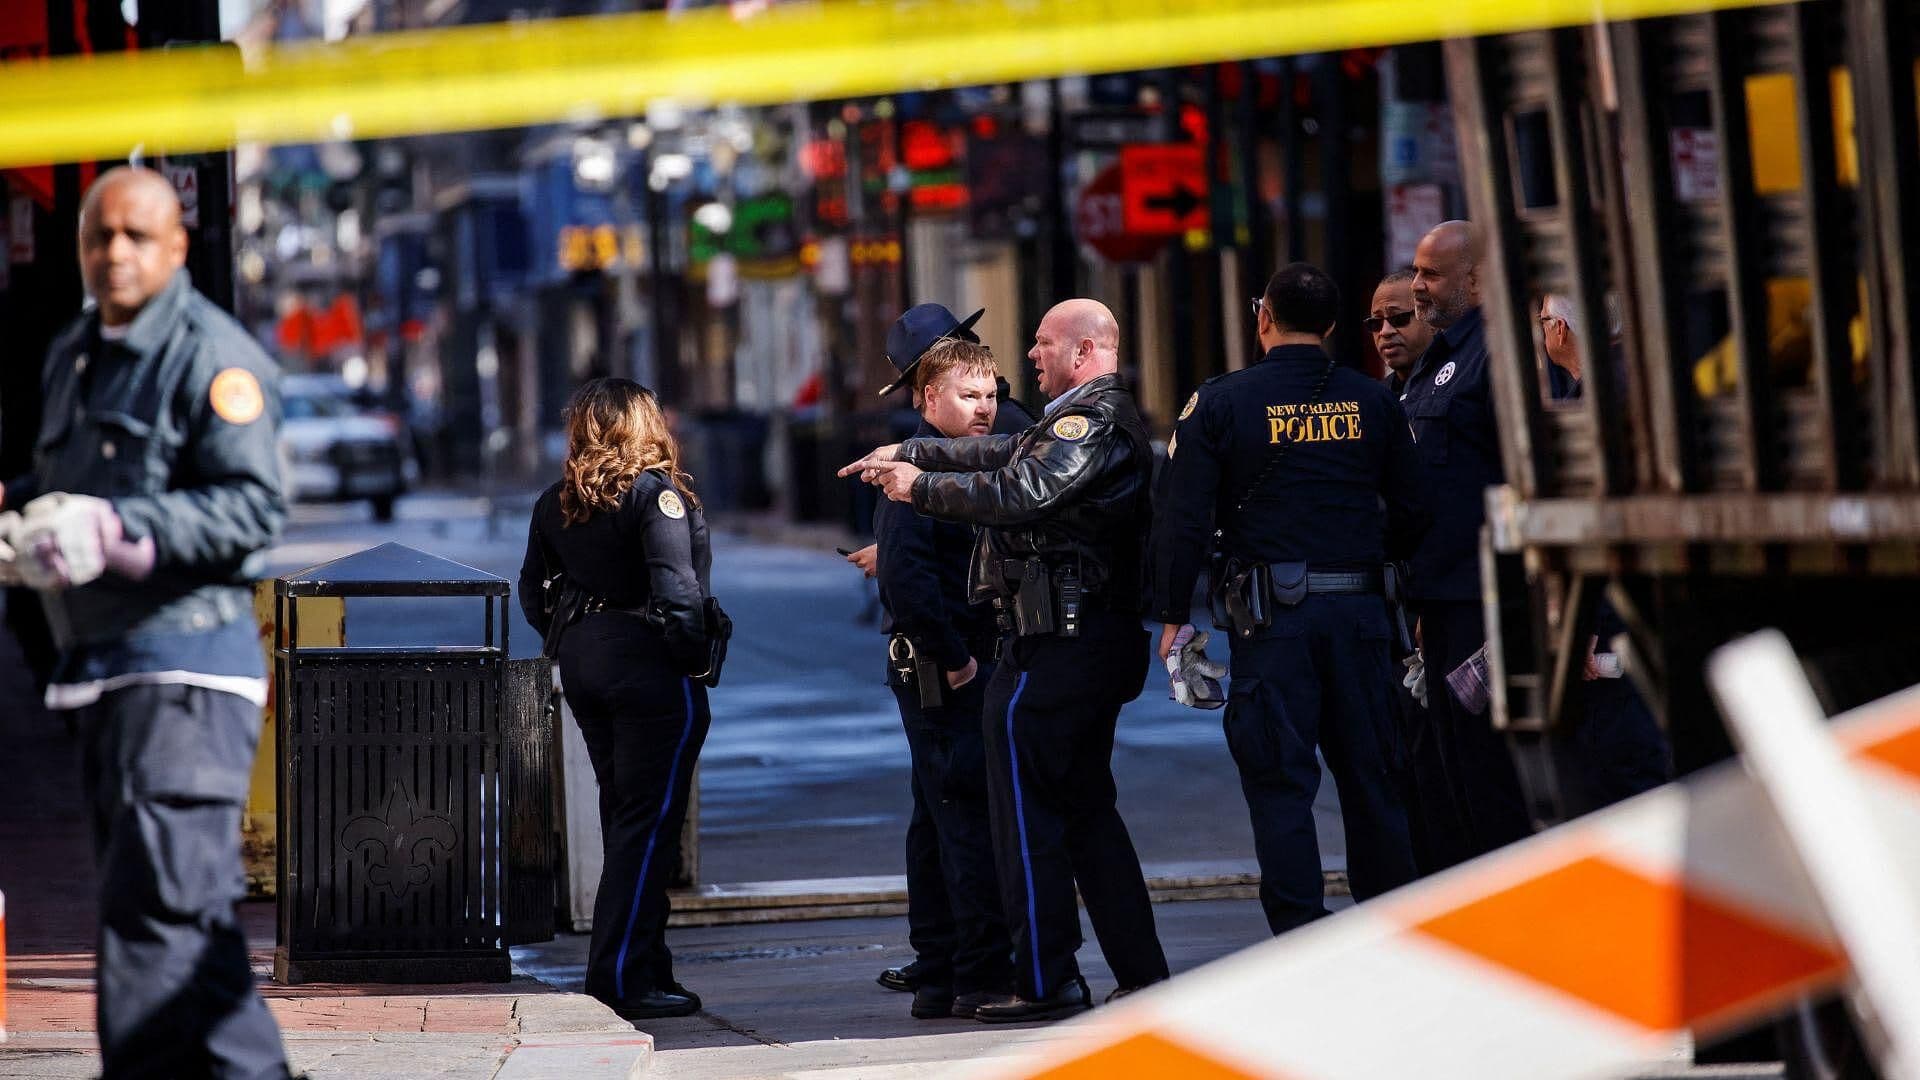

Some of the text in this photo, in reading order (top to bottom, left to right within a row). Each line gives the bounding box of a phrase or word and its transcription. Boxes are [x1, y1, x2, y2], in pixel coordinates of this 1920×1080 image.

[1266, 402, 1359, 416] NEW ORLEANS
[1267, 414, 1361, 444] POLICE
